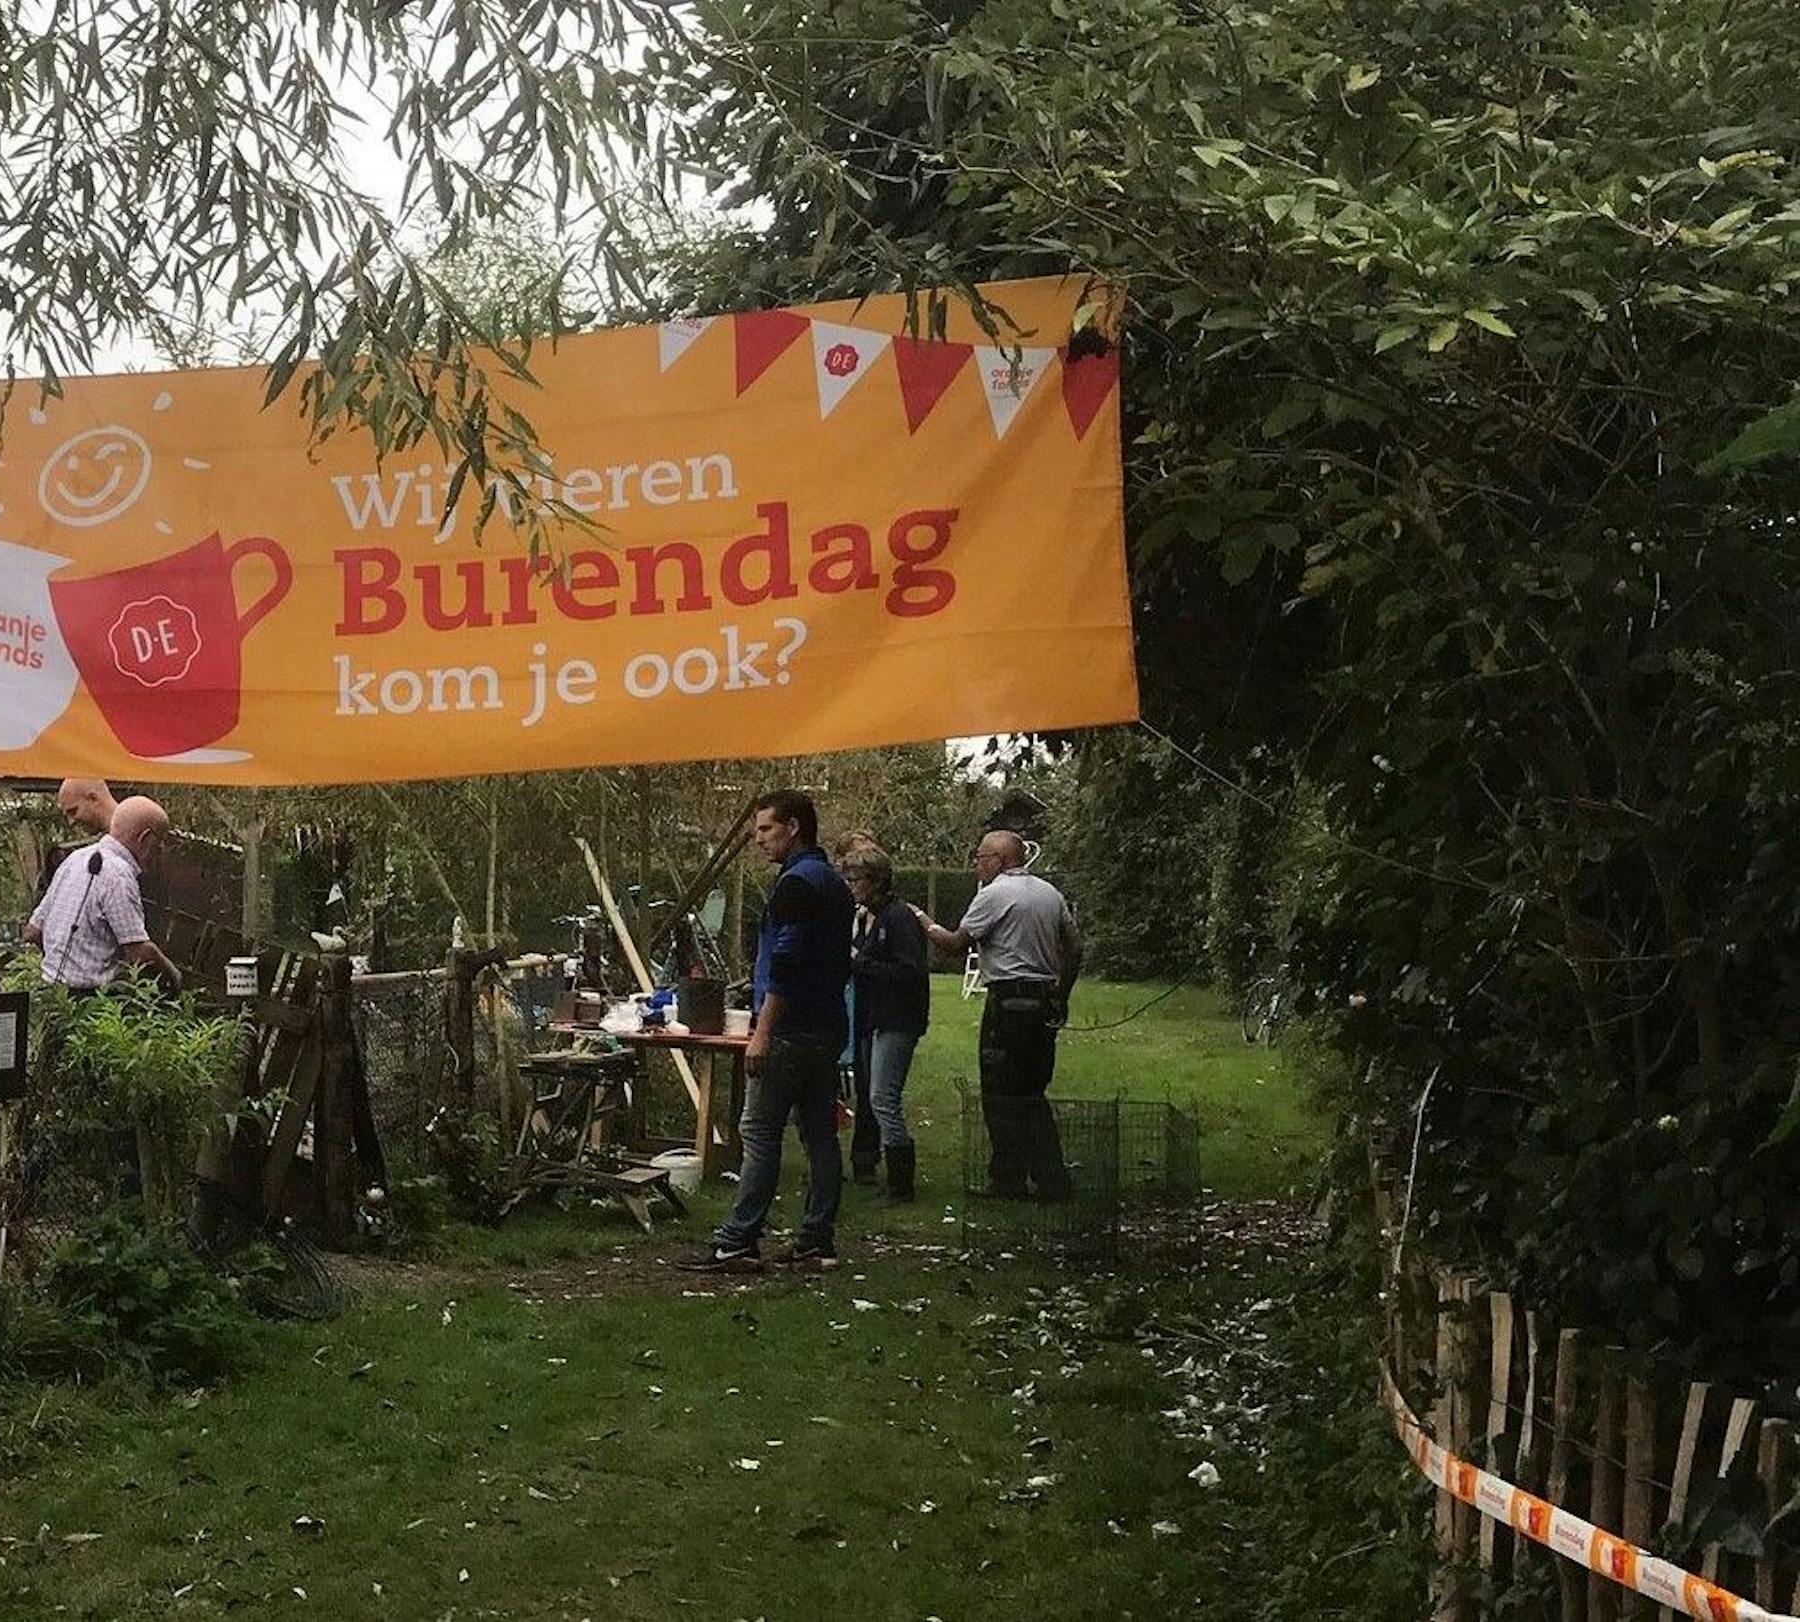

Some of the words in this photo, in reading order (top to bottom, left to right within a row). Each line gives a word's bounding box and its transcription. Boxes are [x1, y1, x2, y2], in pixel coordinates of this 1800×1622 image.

[334, 501, 960, 636] Burendag
[334, 655, 503, 716] kom
[522, 643, 599, 726] je
[624, 617, 808, 700] ook?
